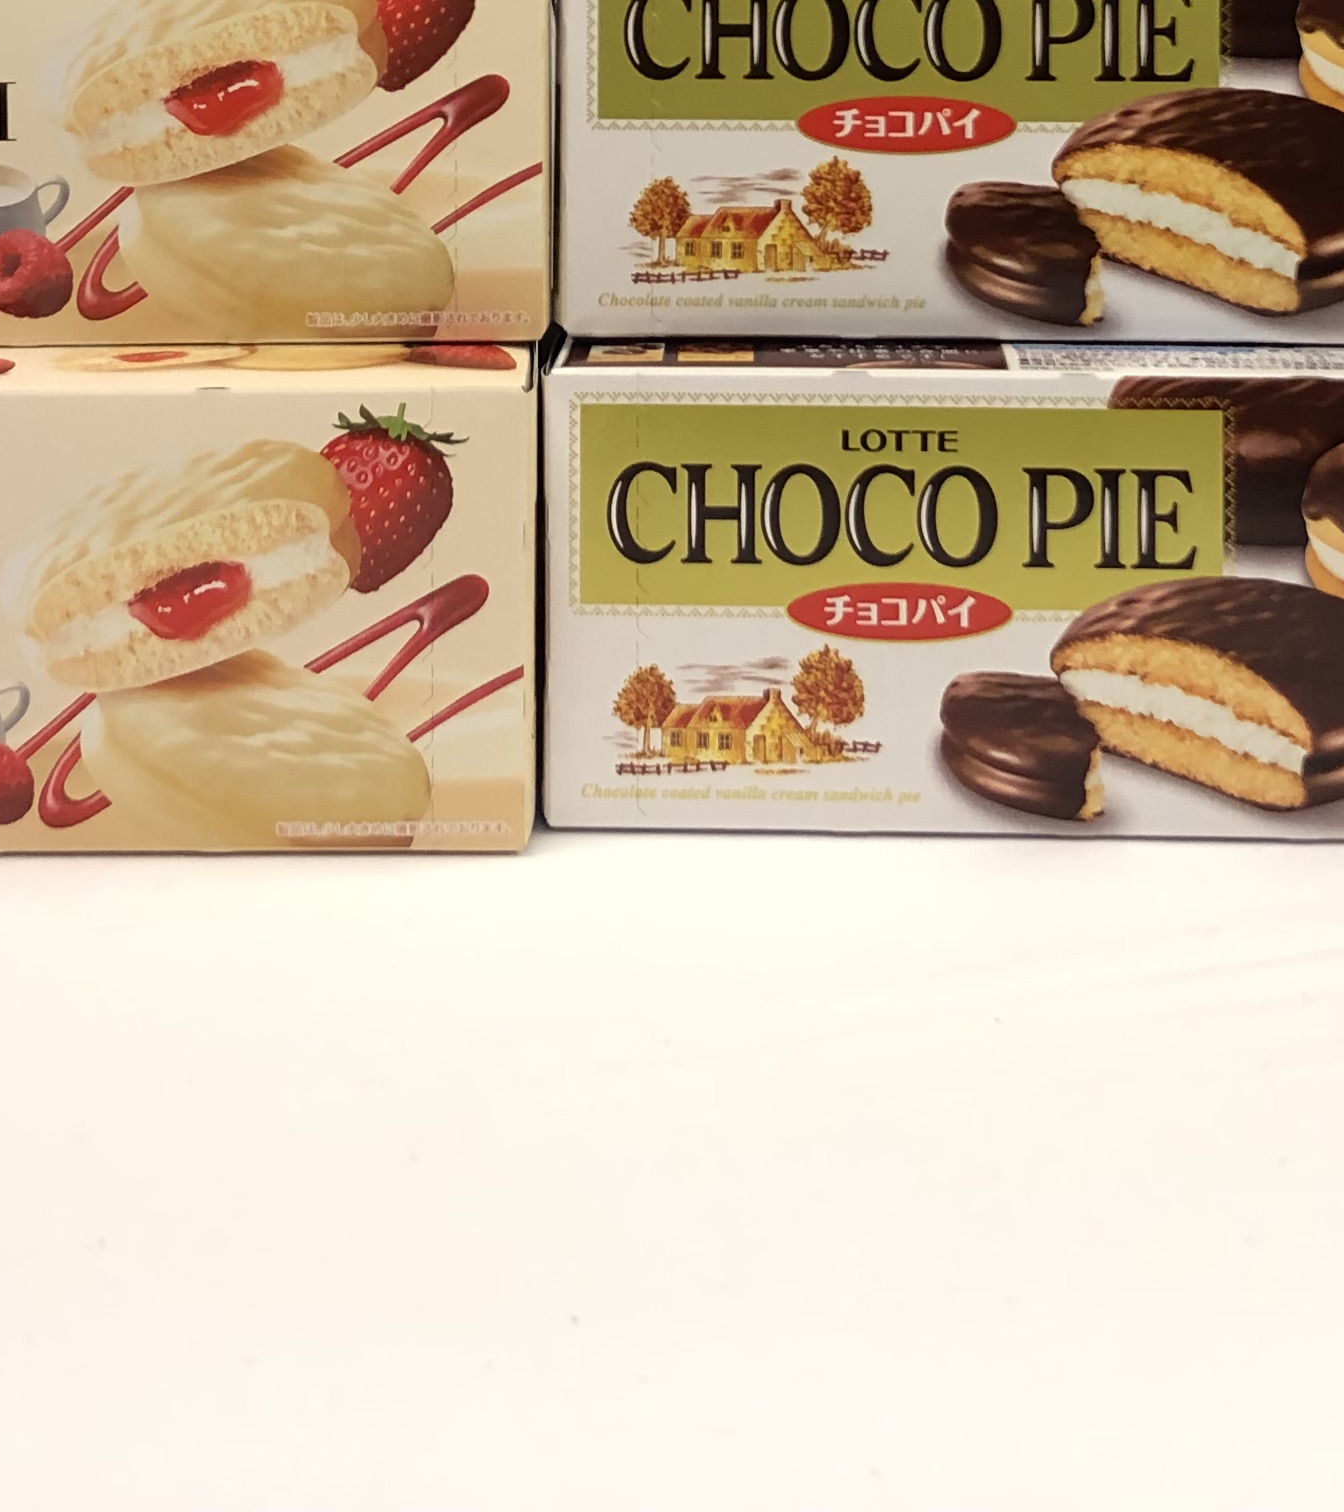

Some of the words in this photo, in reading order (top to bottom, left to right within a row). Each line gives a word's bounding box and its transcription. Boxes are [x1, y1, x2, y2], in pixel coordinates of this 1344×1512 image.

[833, 107, 982, 140] チョコパイ
[598, 292, 671, 309] Chocolate
[675, 293, 723, 309] coated
[727, 294, 778, 309] vanilla
[782, 296, 828, 309] cream
[831, 295, 900, 310] sandwich
[903, 296, 927, 313] pie
[840, 428, 959, 452] LOTTE
[606, 461, 999, 568] CHOCO
[1022, 467, 1197, 570] PIE
[823, 593, 978, 628] チョコパイ
[581, 782, 656, 799] Chocolate
